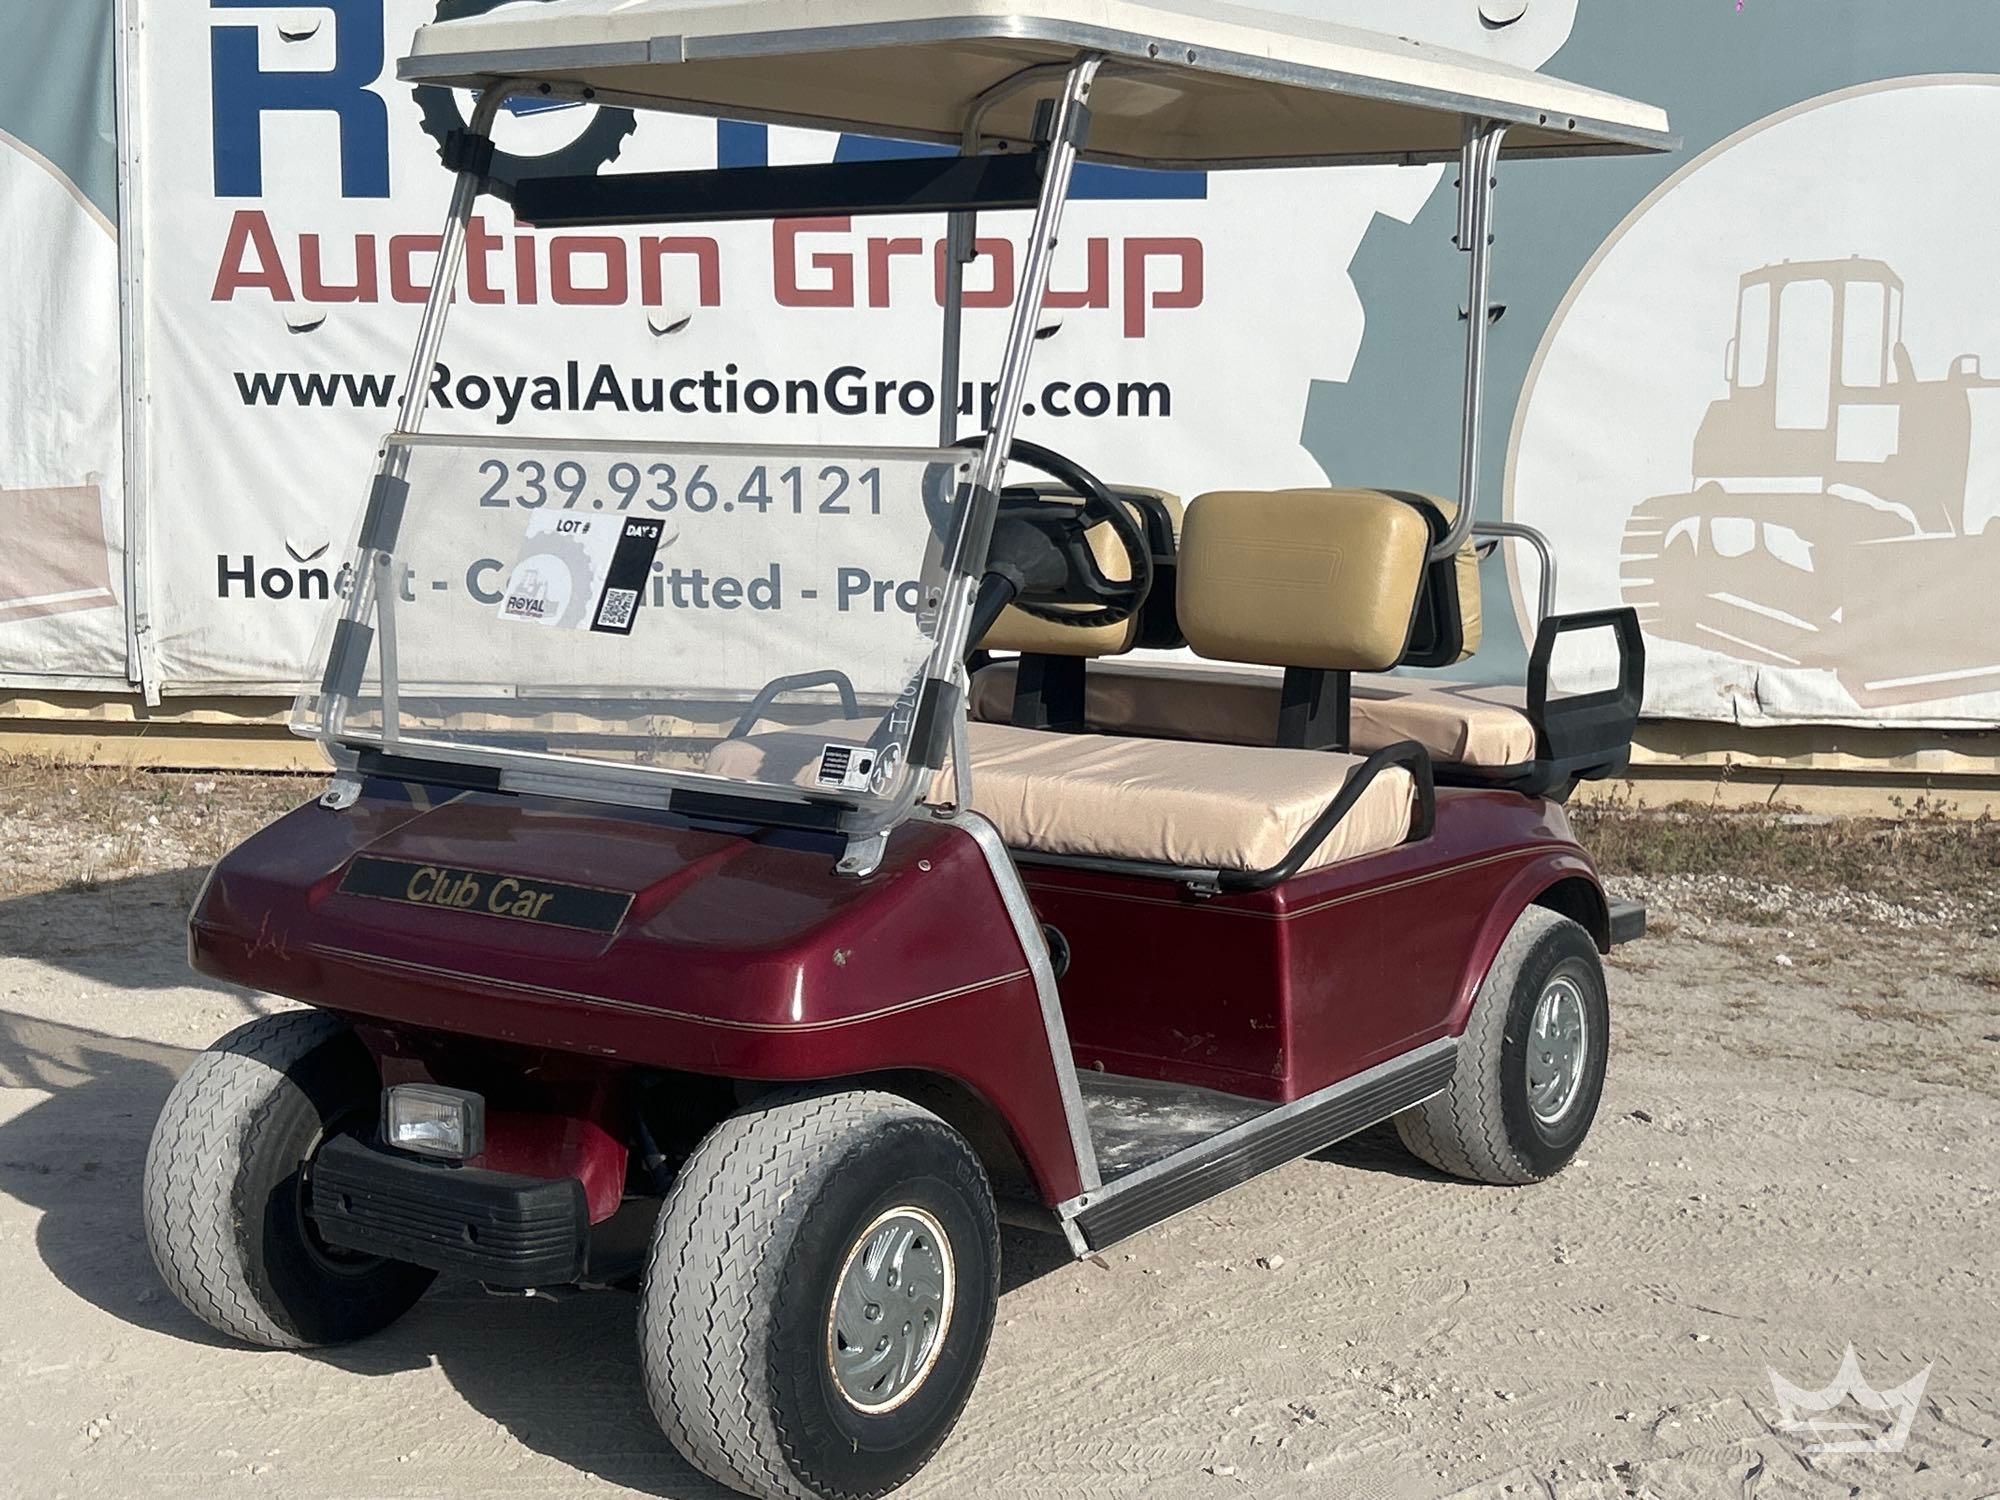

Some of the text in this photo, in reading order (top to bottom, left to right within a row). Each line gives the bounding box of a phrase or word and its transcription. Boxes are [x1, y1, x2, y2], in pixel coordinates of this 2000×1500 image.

[211, 210, 1204, 338] Auction Group
[479, 459, 881, 513] 239.936.4121
[556, 519, 580, 533] LOT
[625, 525, 658, 538] DAY 3
[466, 558, 781, 612] Citted
[507, 596, 545, 613] ROYAL
[406, 866, 553, 918] Club Car
